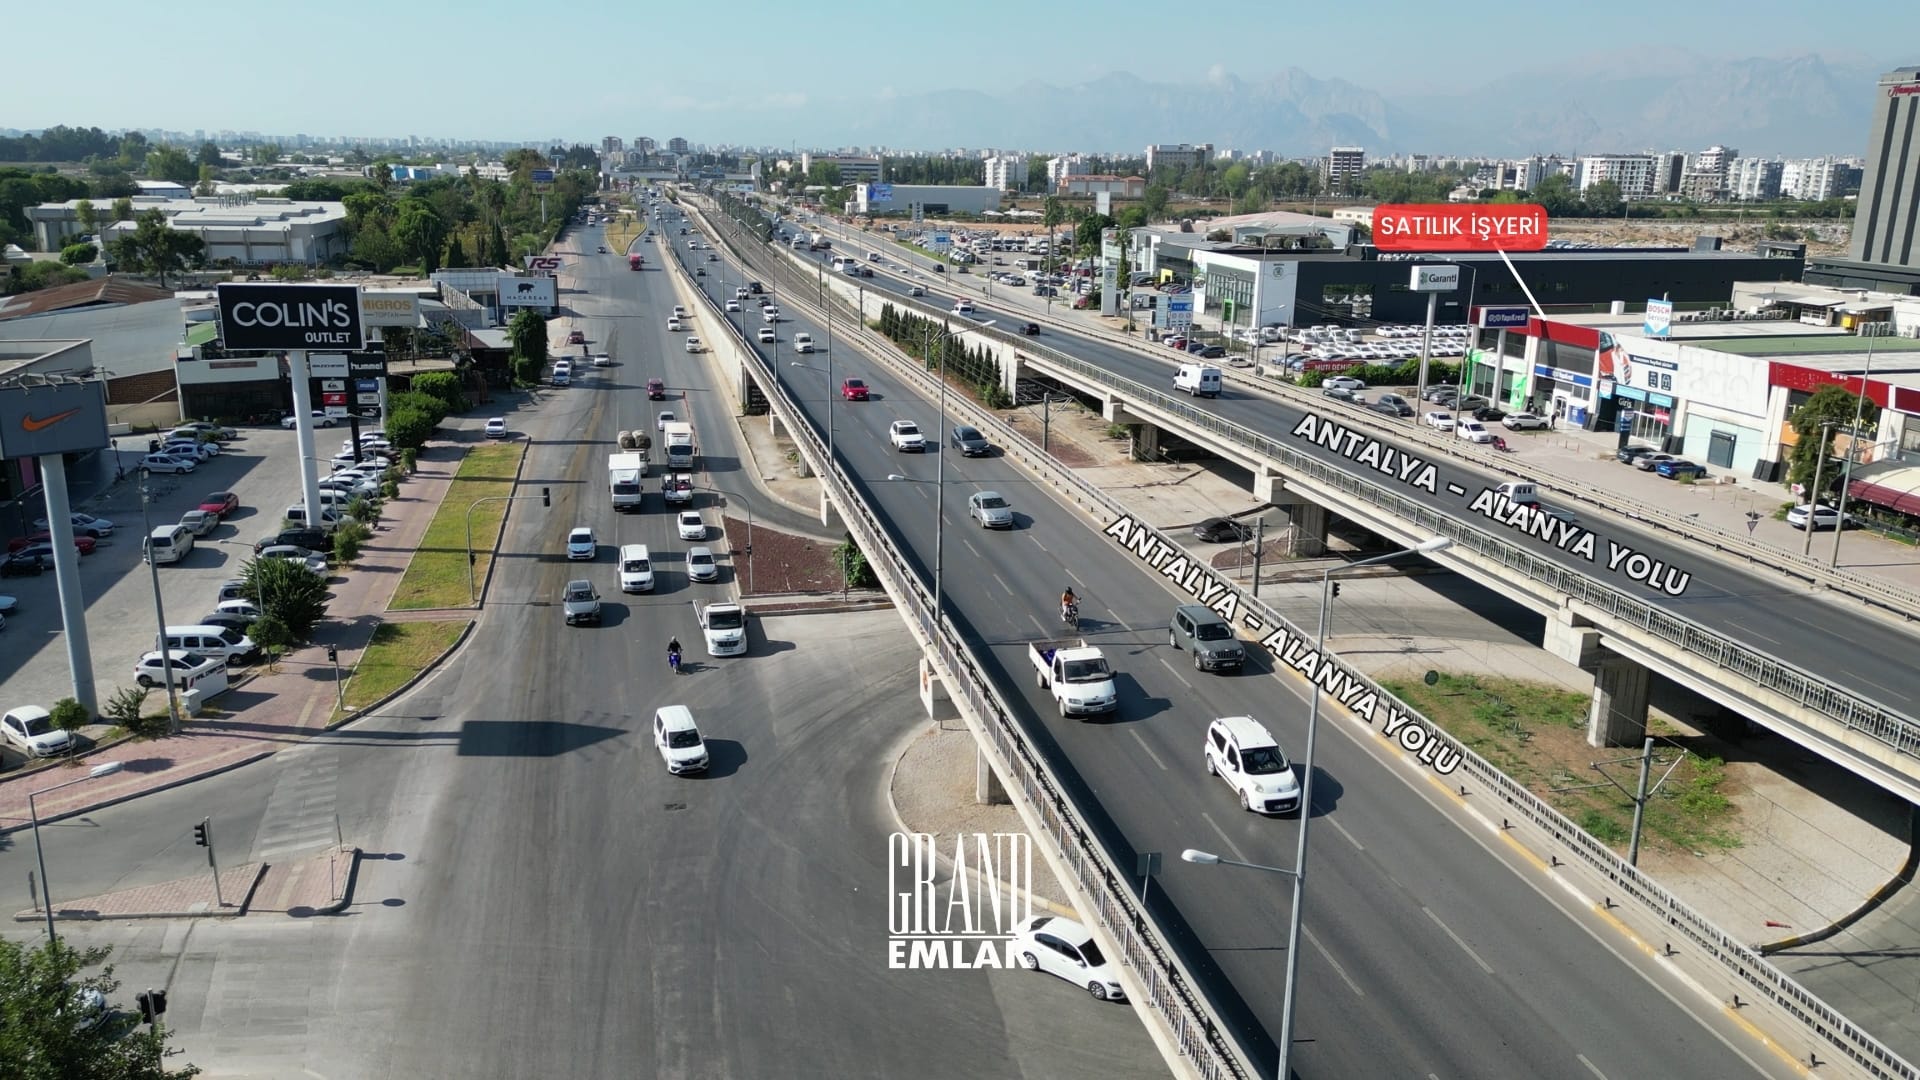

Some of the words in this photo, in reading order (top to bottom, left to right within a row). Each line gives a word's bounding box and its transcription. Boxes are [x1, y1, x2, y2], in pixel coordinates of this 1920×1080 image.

[529, 257, 562, 270] RS
[1429, 273, 1457, 283] Garanti
[362, 299, 413, 311] MIGROS
[232, 299, 350, 328] COLIN'S
[305, 332, 351, 343] OUTLET
[350, 361, 383, 371] hummel
